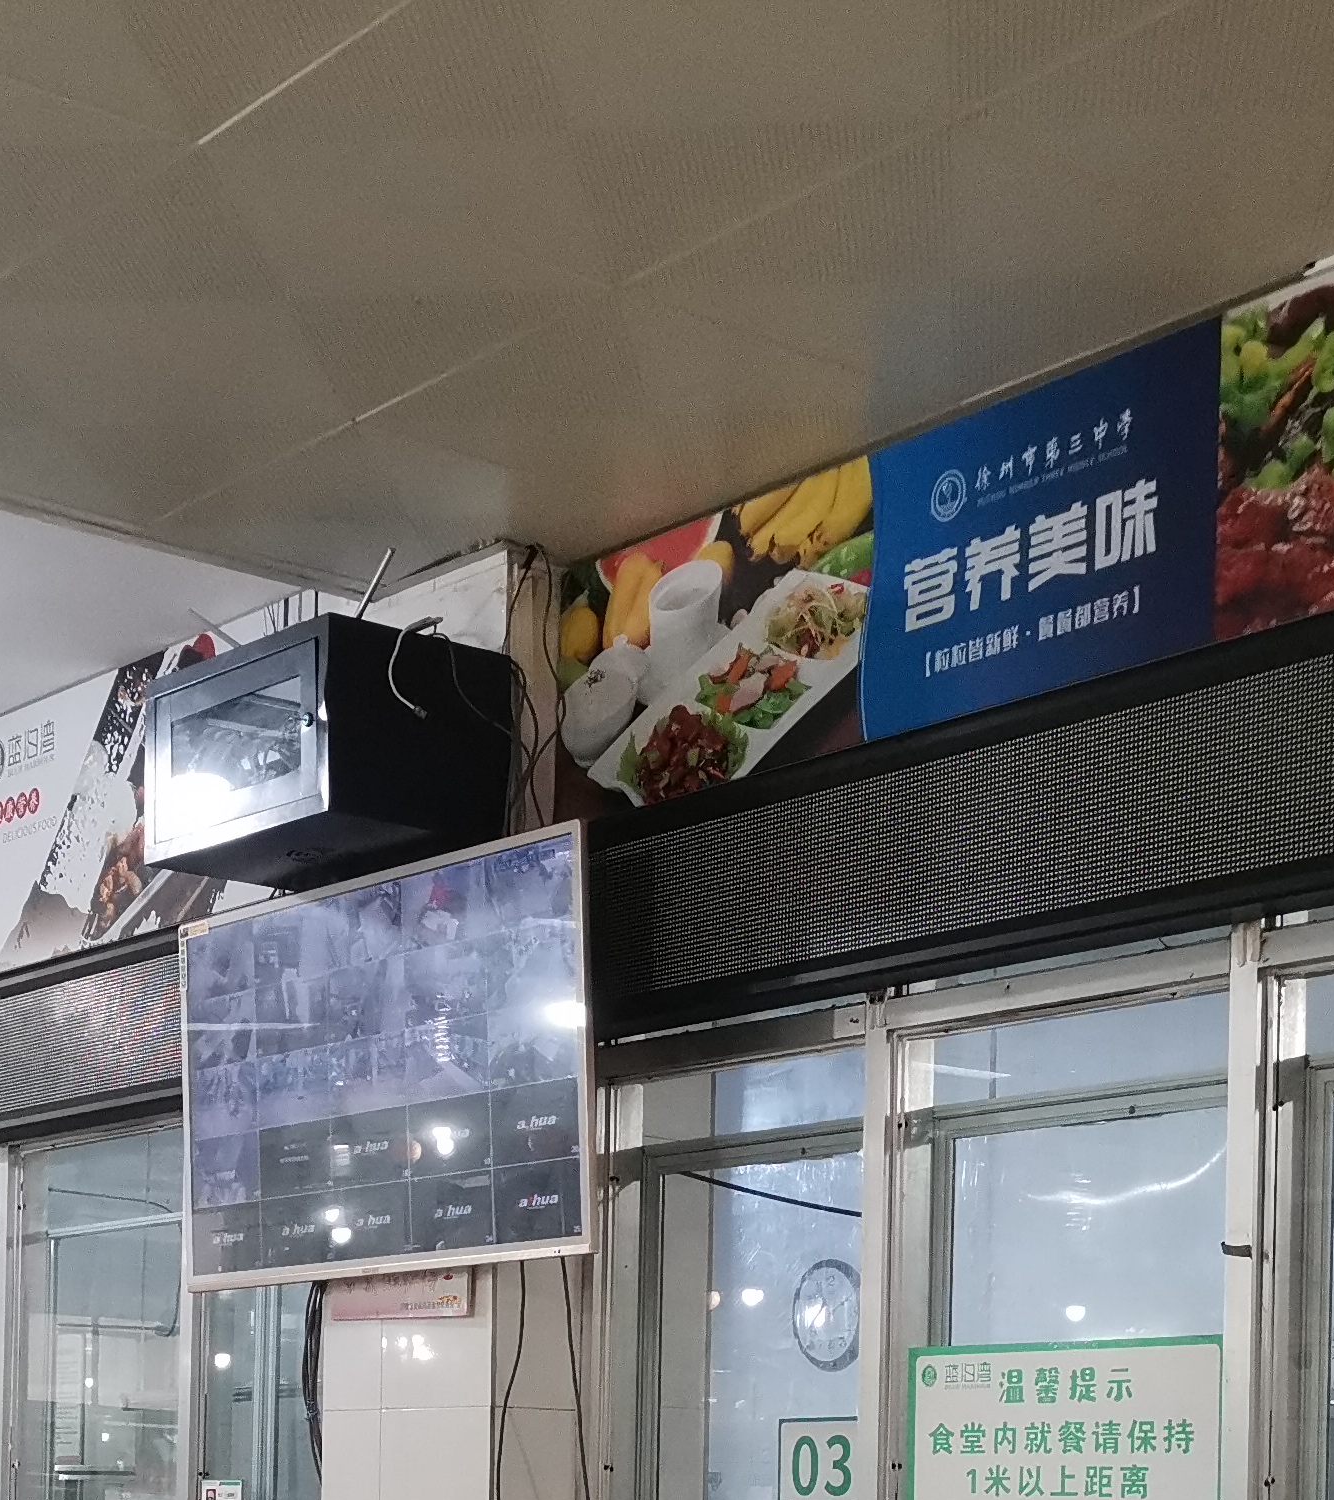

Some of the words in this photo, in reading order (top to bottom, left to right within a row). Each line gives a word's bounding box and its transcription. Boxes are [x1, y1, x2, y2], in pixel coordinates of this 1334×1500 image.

[975, 408, 1133, 492] 徐州市第三中学
[903, 478, 1158, 633] 营养美味
[998, 1366, 1134, 1405] 温馨提示
[928, 1418, 1196, 1457] 食堂内就餐请保持
[791, 1434, 853, 1497] 03
[966, 1463, 1150, 1500] 1米以上距离
